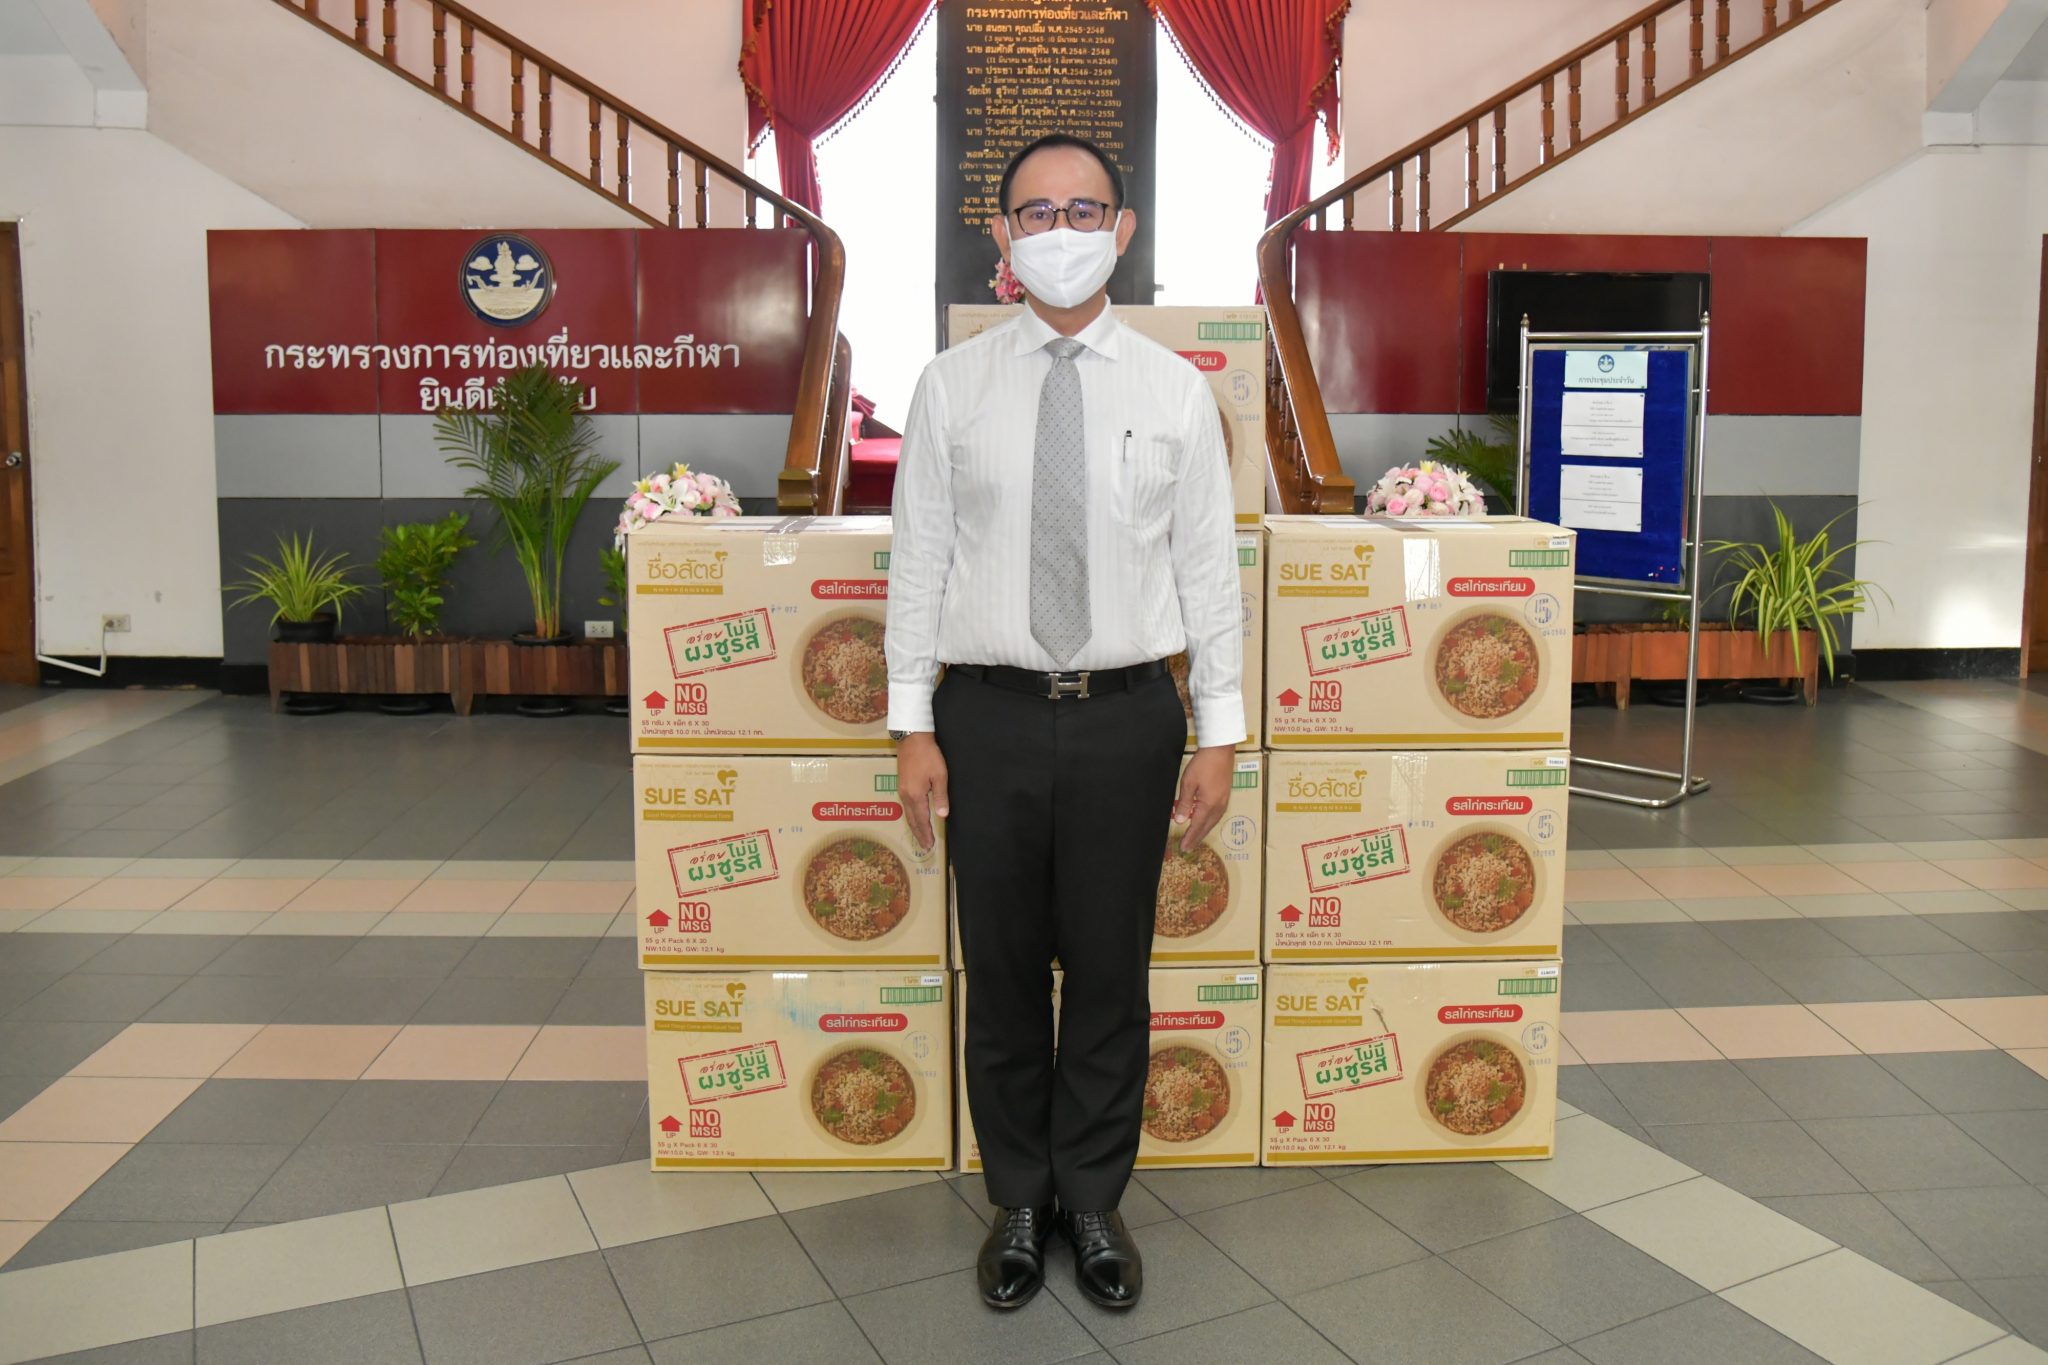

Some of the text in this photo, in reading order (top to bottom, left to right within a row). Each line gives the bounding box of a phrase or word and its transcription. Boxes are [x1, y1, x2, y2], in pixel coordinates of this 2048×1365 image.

[967, 5, 1128, 20] กระทรวงการท่องเที่ยวและกีฬา
[265, 326, 740, 369] กระทรวงการท่องเที่ยวและกีฬา
[1280, 564, 1371, 581] SUE SAT
[819, 581, 888, 595] รสไก่กระเทีย
[1454, 580, 1526, 593] รสไก่กระเทียม
[723, 617, 757, 639] ไม่มี
[1361, 616, 1393, 636] ไม่มี
[684, 632, 760, 664] ผงชูรส
[1321, 630, 1395, 660] ผงชูรส
[676, 685, 707, 702] NO
[1311, 682, 1341, 699] NO
[650, 709, 661, 717] UP
[676, 702, 707, 714] MSG
[1311, 700, 1341, 711] MSG
[644, 788, 735, 806] SUE SAT
[1453, 798, 1524, 811] รสไก่กระเทียม
[819, 804, 894, 817] รสไก่กระเทียม
[726, 838, 759, 858] ไม่มี
[1361, 834, 1392, 854] ไม่มี
[687, 853, 762, 882] ผงชูรส
[1322, 849, 1395, 877] ผงชูรส
[680, 903, 710, 920] NO
[1311, 898, 1339, 915] NO
[680, 921, 710, 932] MSG
[1311, 915, 1339, 926] MSG
[656, 1000, 743, 1017] SUE SAT
[1277, 995, 1364, 1012] SUE SAT
[826, 1015, 899, 1028] รสไก่กระเทียม
[1150, 1014, 1216, 1026] สไก่กระเทียม
[1445, 1007, 1515, 1020] รสไก่กระเทียม
[735, 1049, 767, 1069] ไม่มี
[1354, 1043, 1386, 1062] ไม่มี
[698, 1063, 770, 1091] ผงชูรส
[1316, 1057, 1388, 1085] ผงชูรส
[691, 1110, 719, 1127] NO
[1305, 1104, 1334, 1120] NO
[691, 1127, 720, 1138] MSG
[1305, 1120, 1334, 1131] MSG
